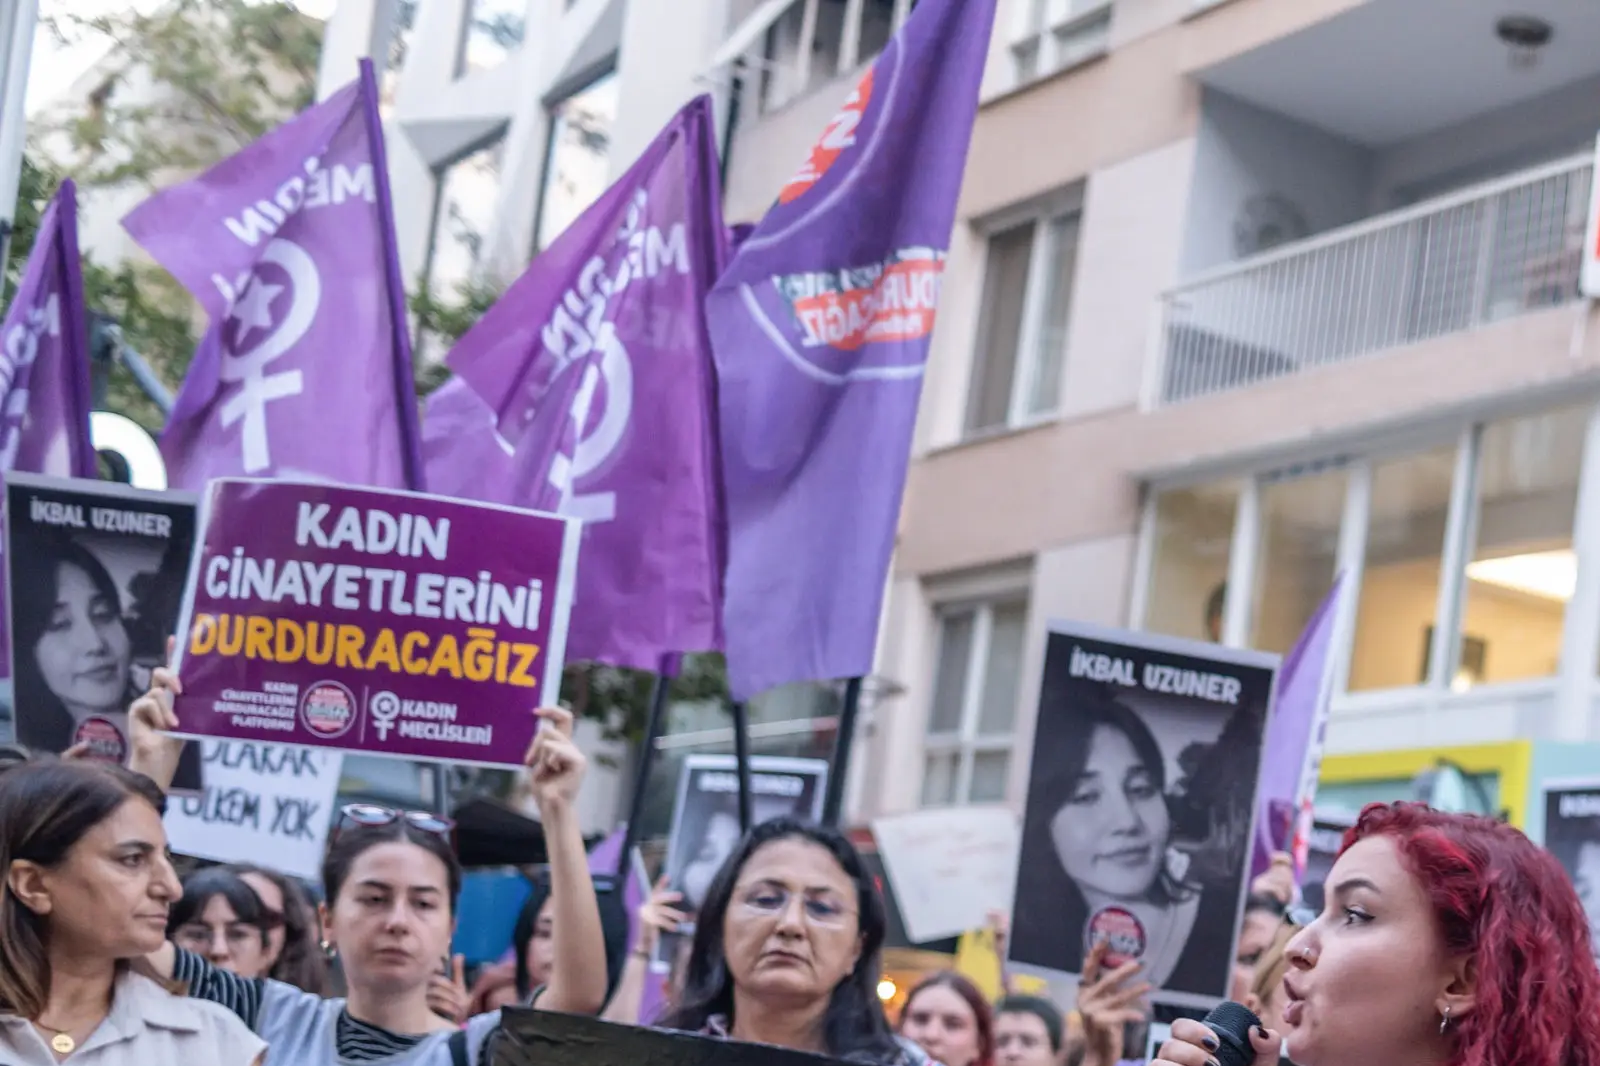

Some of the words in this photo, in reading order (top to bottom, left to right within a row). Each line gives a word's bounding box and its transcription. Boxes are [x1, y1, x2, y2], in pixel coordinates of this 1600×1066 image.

[30, 496, 87, 528] İKBAL
[91, 507, 173, 538] UZUNER
[295, 501, 450, 560] KADIN
[205, 547, 543, 631] CİNAYETLERİNİ
[190, 613, 540, 688] DURDURACAĞIZ
[1070, 646, 1137, 687] İKBAL
[1143, 664, 1243, 704] UZUNER
[400, 718, 493, 746] MECLİSLERİ
[402, 699, 458, 721] KADIN
